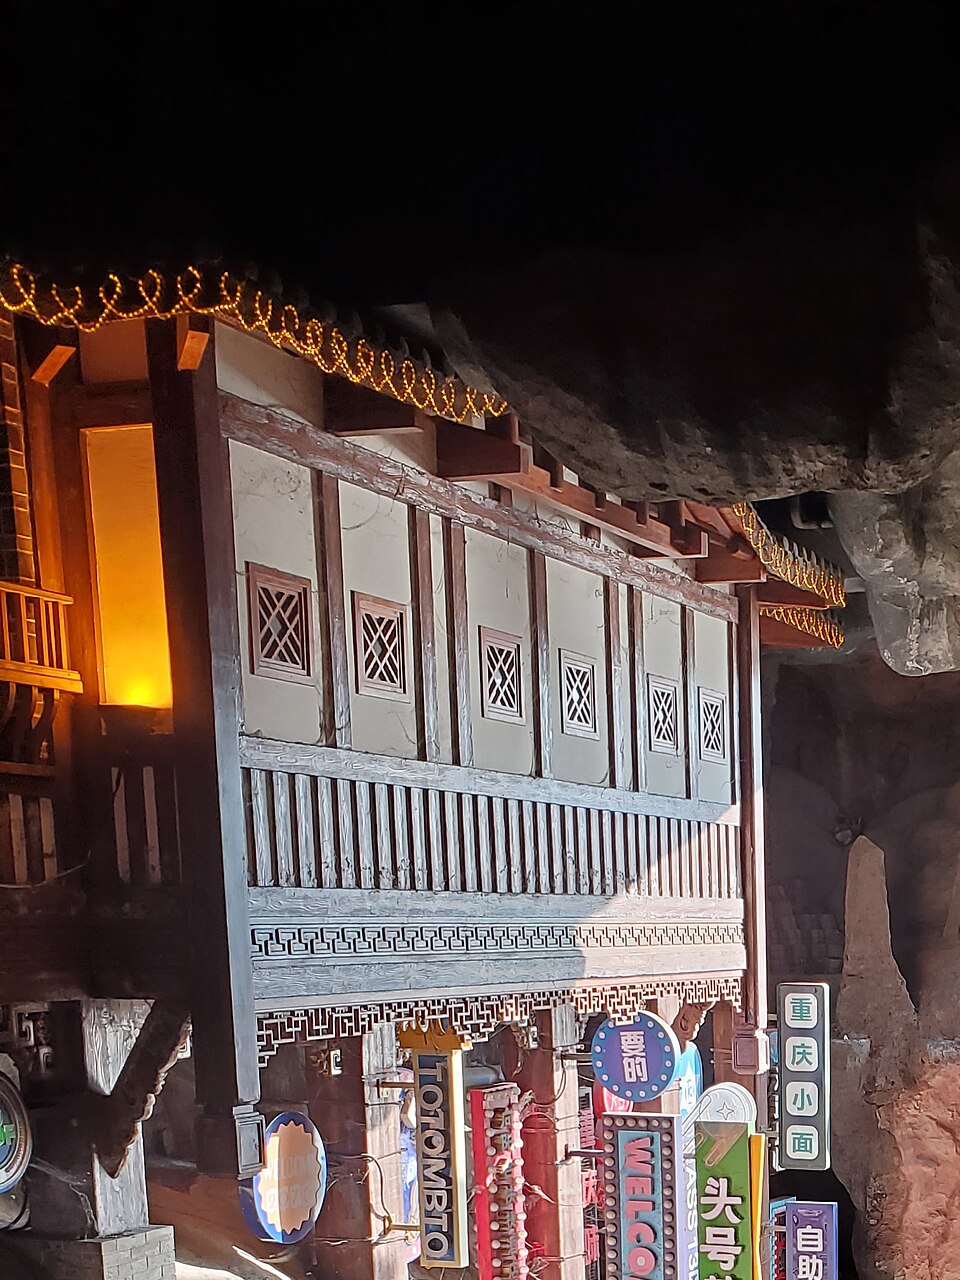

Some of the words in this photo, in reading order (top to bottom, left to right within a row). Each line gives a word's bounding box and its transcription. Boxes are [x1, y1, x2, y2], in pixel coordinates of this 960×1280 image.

[619, 1031, 649, 1083] 要的
[790, 997, 814, 1154] 重庆小面
[418, 1062, 449, 1260] TOTOMBTO
